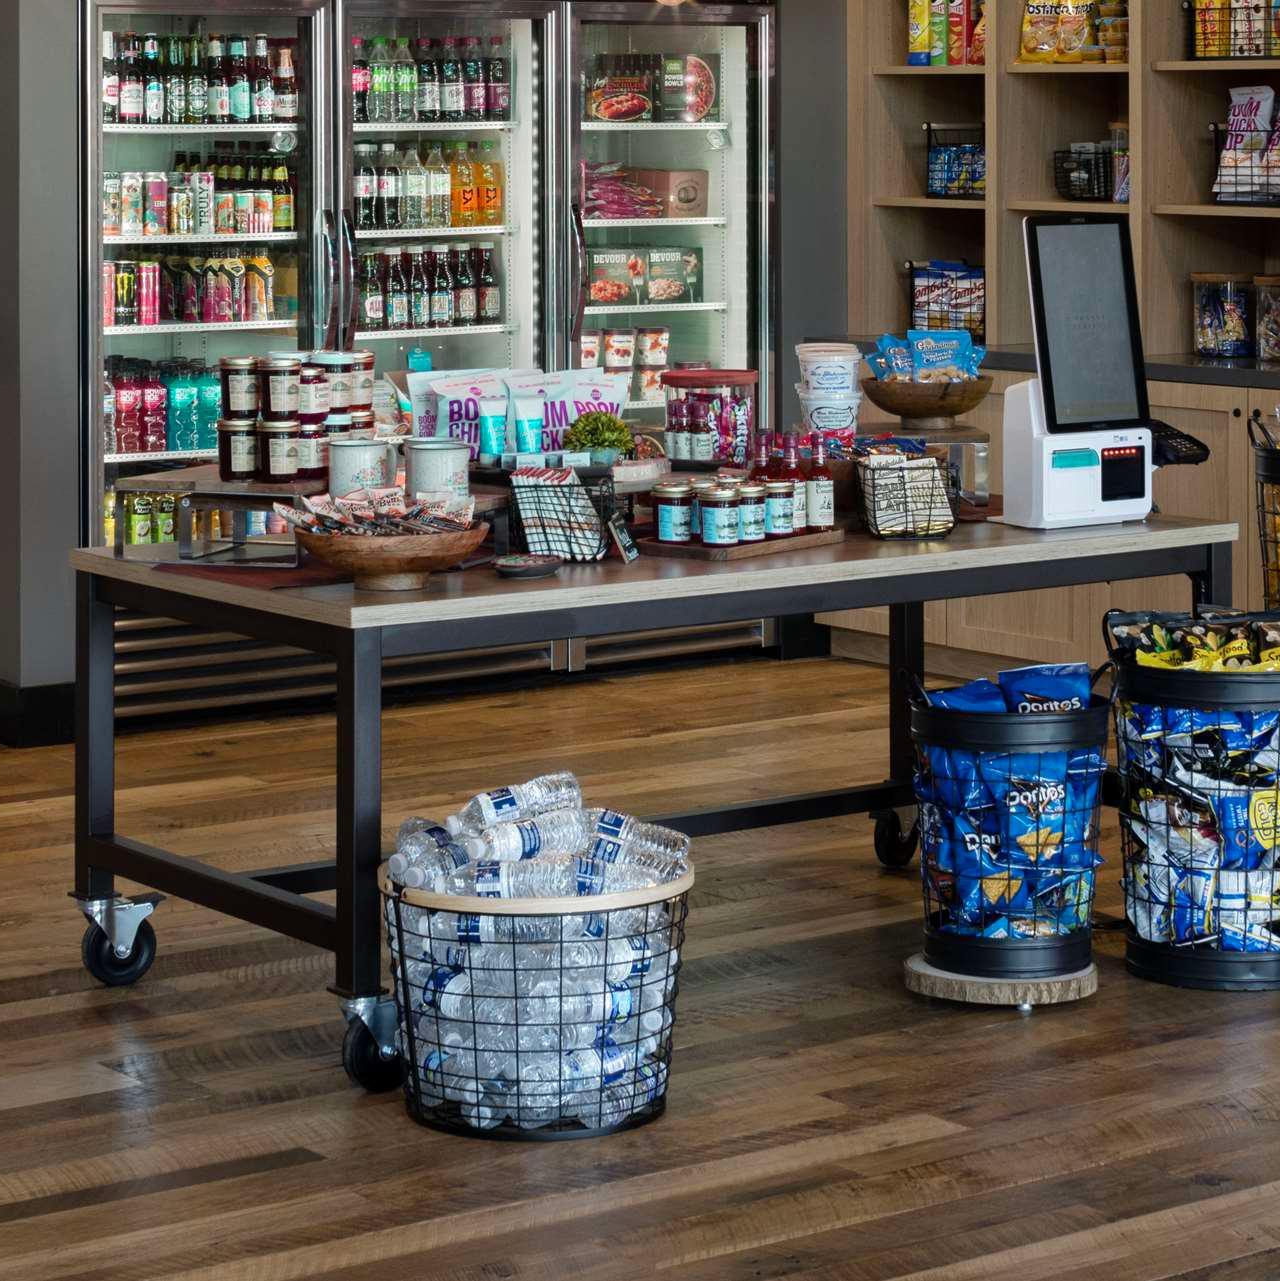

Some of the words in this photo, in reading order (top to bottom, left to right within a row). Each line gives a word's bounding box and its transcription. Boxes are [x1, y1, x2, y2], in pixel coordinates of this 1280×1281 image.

[198, 185, 210, 227] TRULY
[593, 254, 627, 265] DEVOUR
[649, 252, 682, 263] DEVOUR
[448, 397, 479, 423] BO
[448, 422, 480, 444] CHI
[734, 404, 749, 465] Skittles
[1017, 696, 1082, 715] Doritos
[1006, 783, 1066, 806] Doritos
